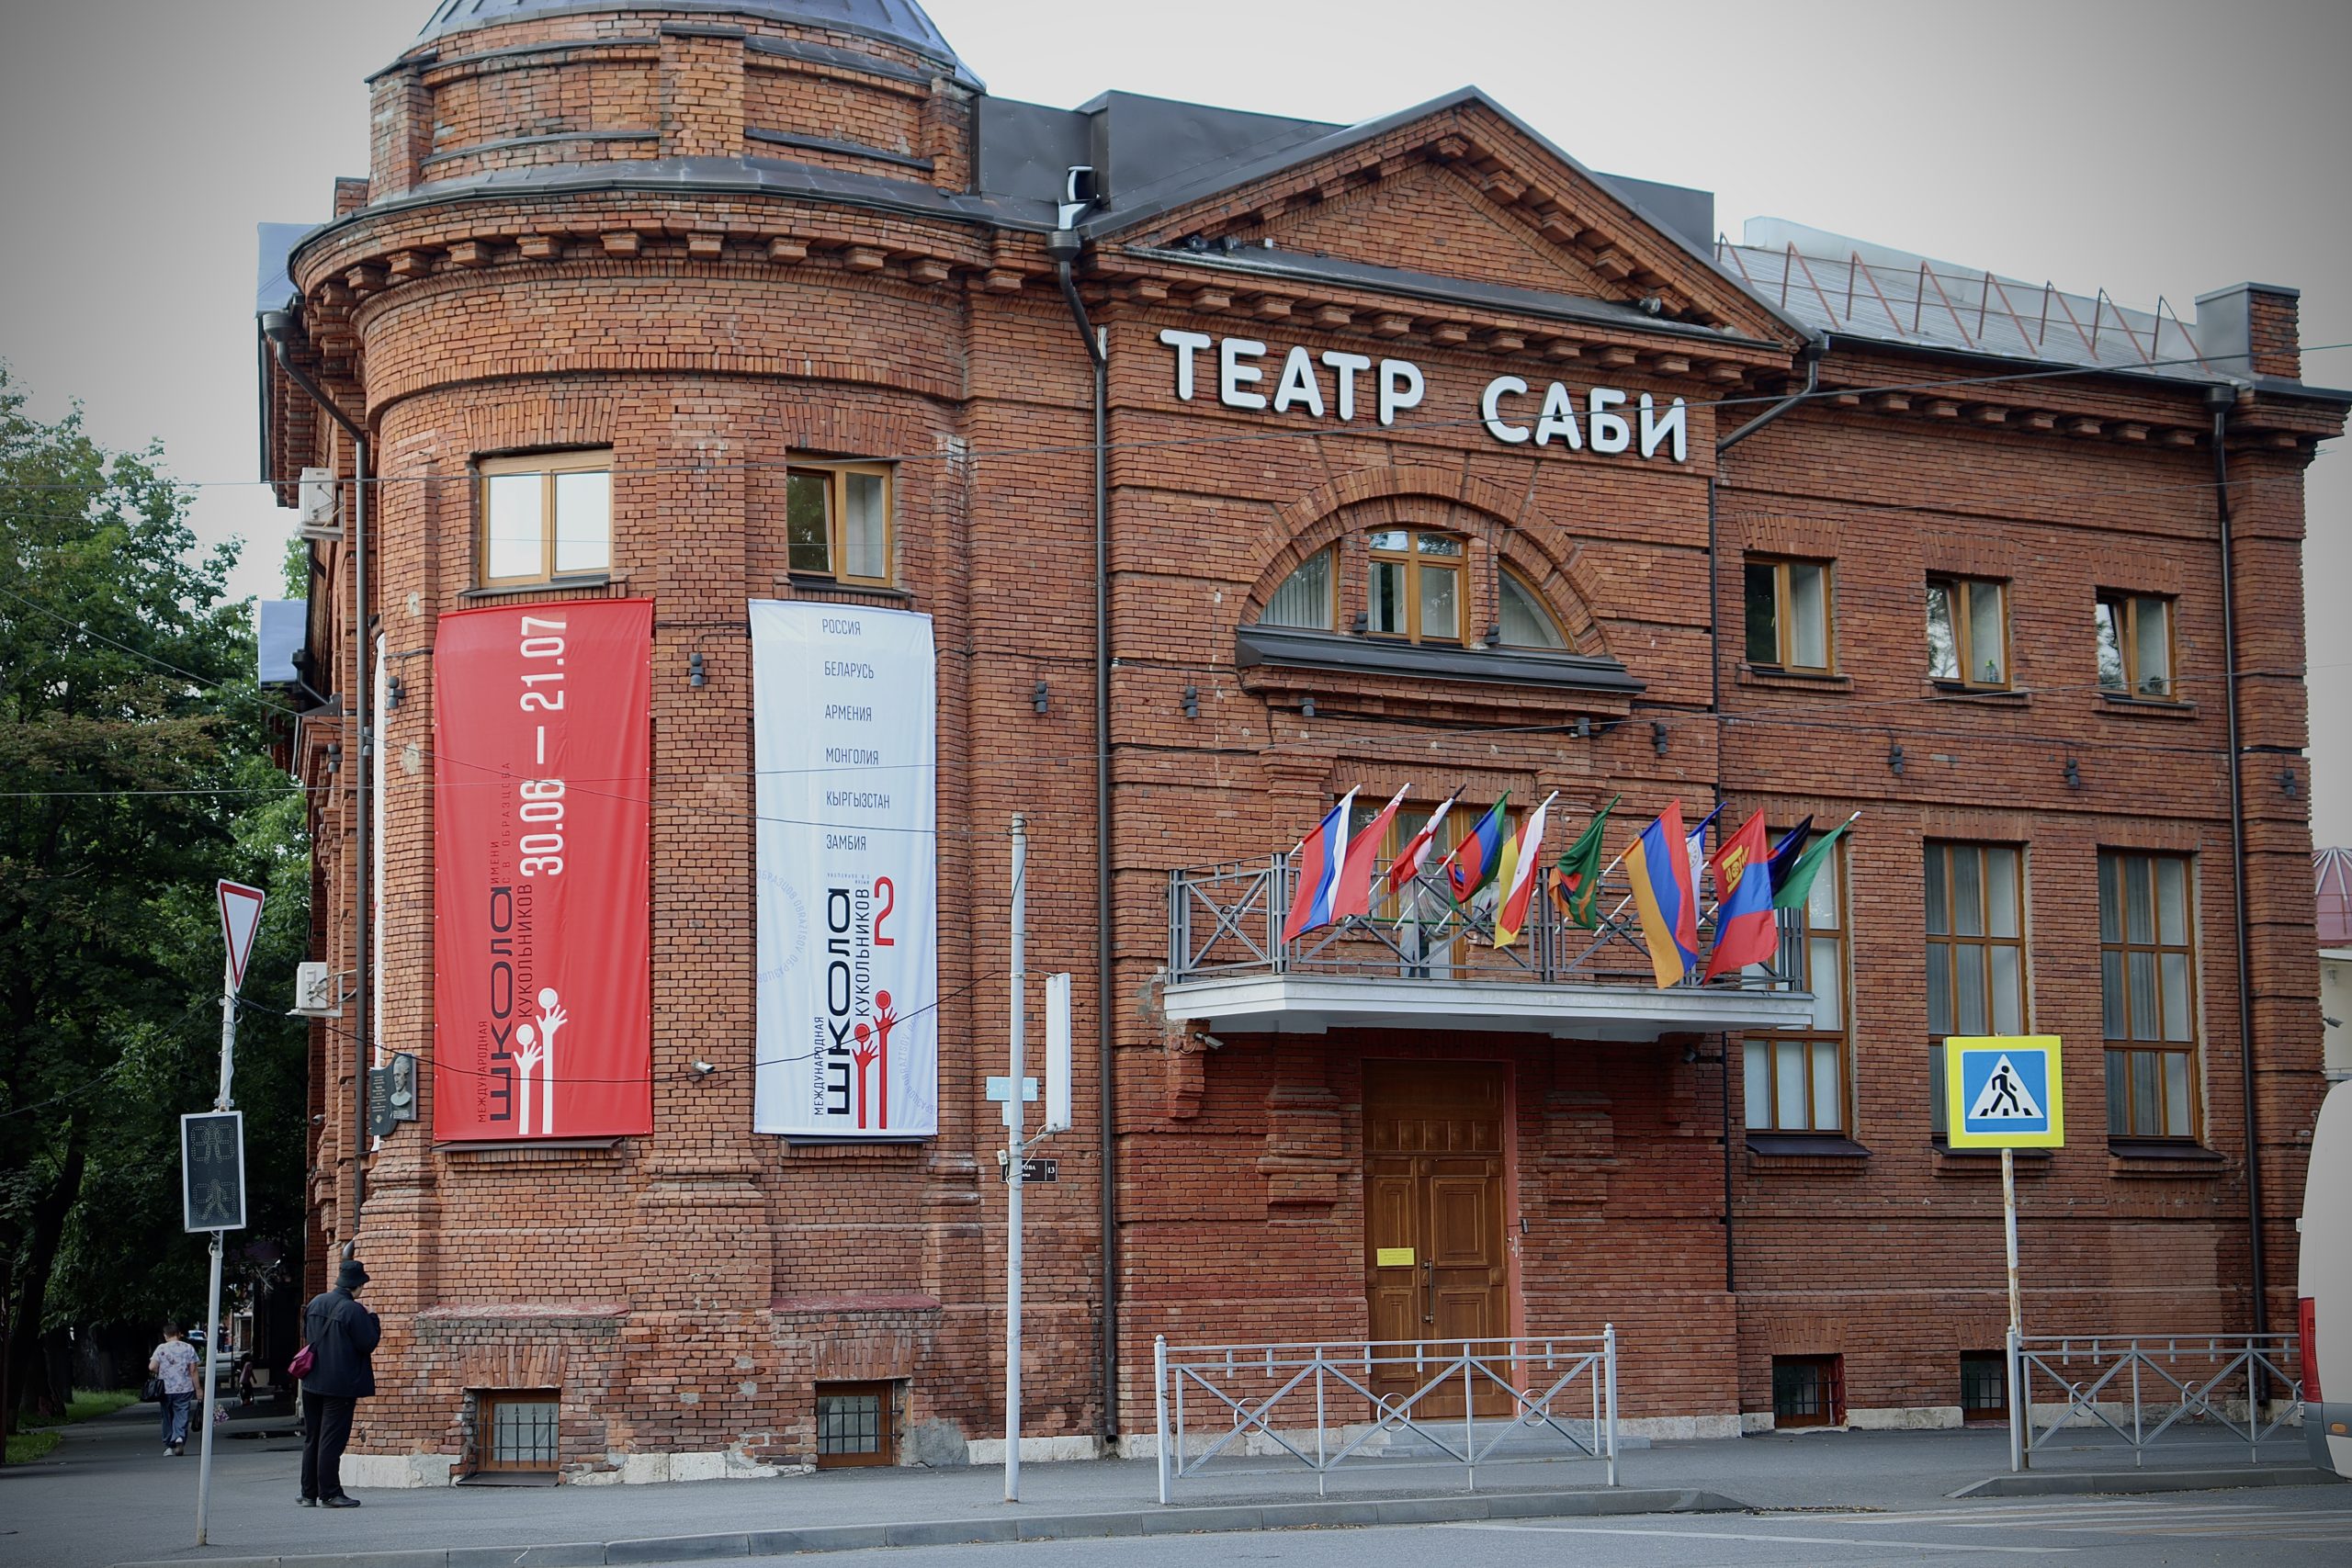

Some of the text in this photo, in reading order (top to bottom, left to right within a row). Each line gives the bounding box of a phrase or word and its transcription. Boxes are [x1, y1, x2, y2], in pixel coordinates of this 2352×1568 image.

[1159, 329, 1687, 463] ТЕАТР САБИ
[822, 618, 861, 636] РОССИЯ
[520, 615, 567, 711] 21.07
[824, 660, 874, 679] БЕЛАРУСЬ
[825, 705, 872, 722] АРМЕНИЯ
[826, 747, 879, 765] МОНГОЛИЯ
[520, 779, 566, 876] 30.06
[826, 791, 890, 809] КЫРГЫЗСТАН
[492, 840, 500, 884] ИМЕНИ
[826, 833, 866, 851] ЗАМБИЯ
[874, 875, 895, 946] 2
[517, 884, 533, 1018] КУКОЛЬНИКОВ
[855, 888, 870, 1017] КУКОЛЬНИКОВ
[478, 1021, 488, 1122] МЕЖДУНАРОДНАЯ
[814, 1016, 824, 1115] МЕЖДУНАРОДНАЯ
